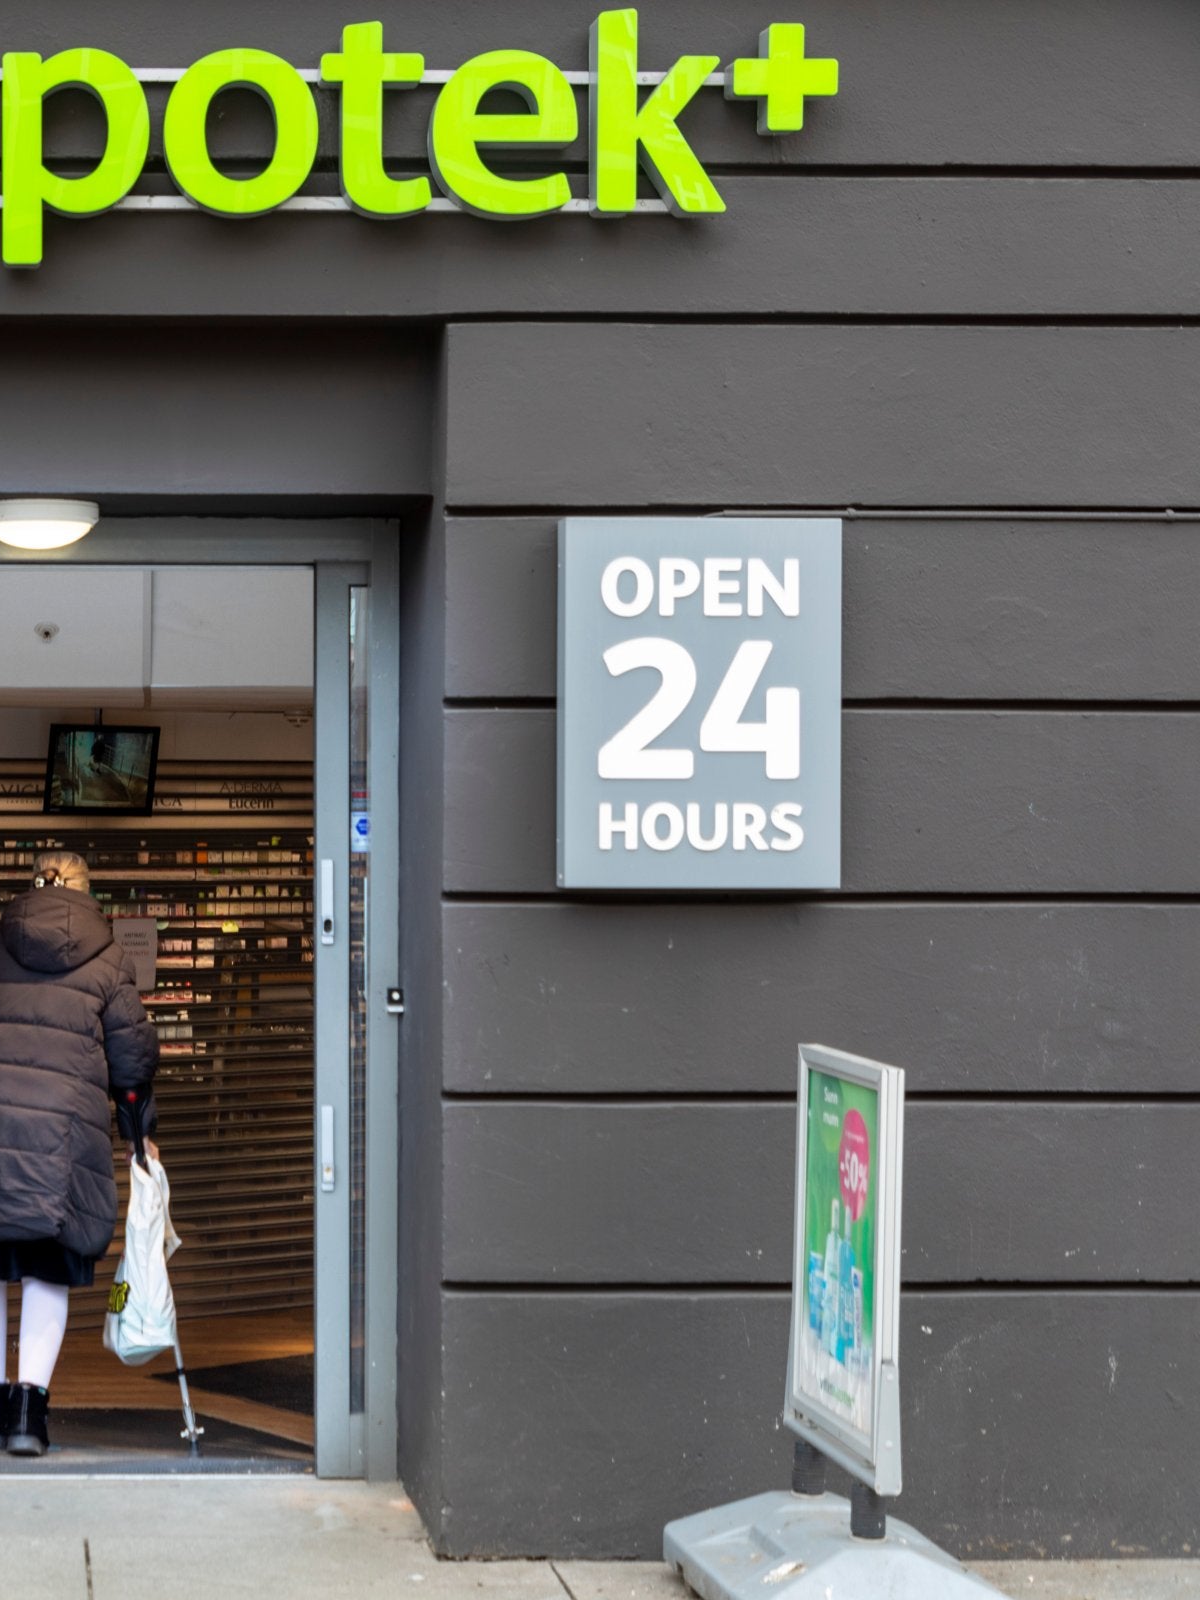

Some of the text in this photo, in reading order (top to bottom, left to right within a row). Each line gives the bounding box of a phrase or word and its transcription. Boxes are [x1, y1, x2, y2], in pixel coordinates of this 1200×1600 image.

[601, 556, 800, 618] OPEN
[598, 636, 800, 780] 24
[599, 801, 805, 852] HOURS
[840, 1148, 868, 1193] -50%
